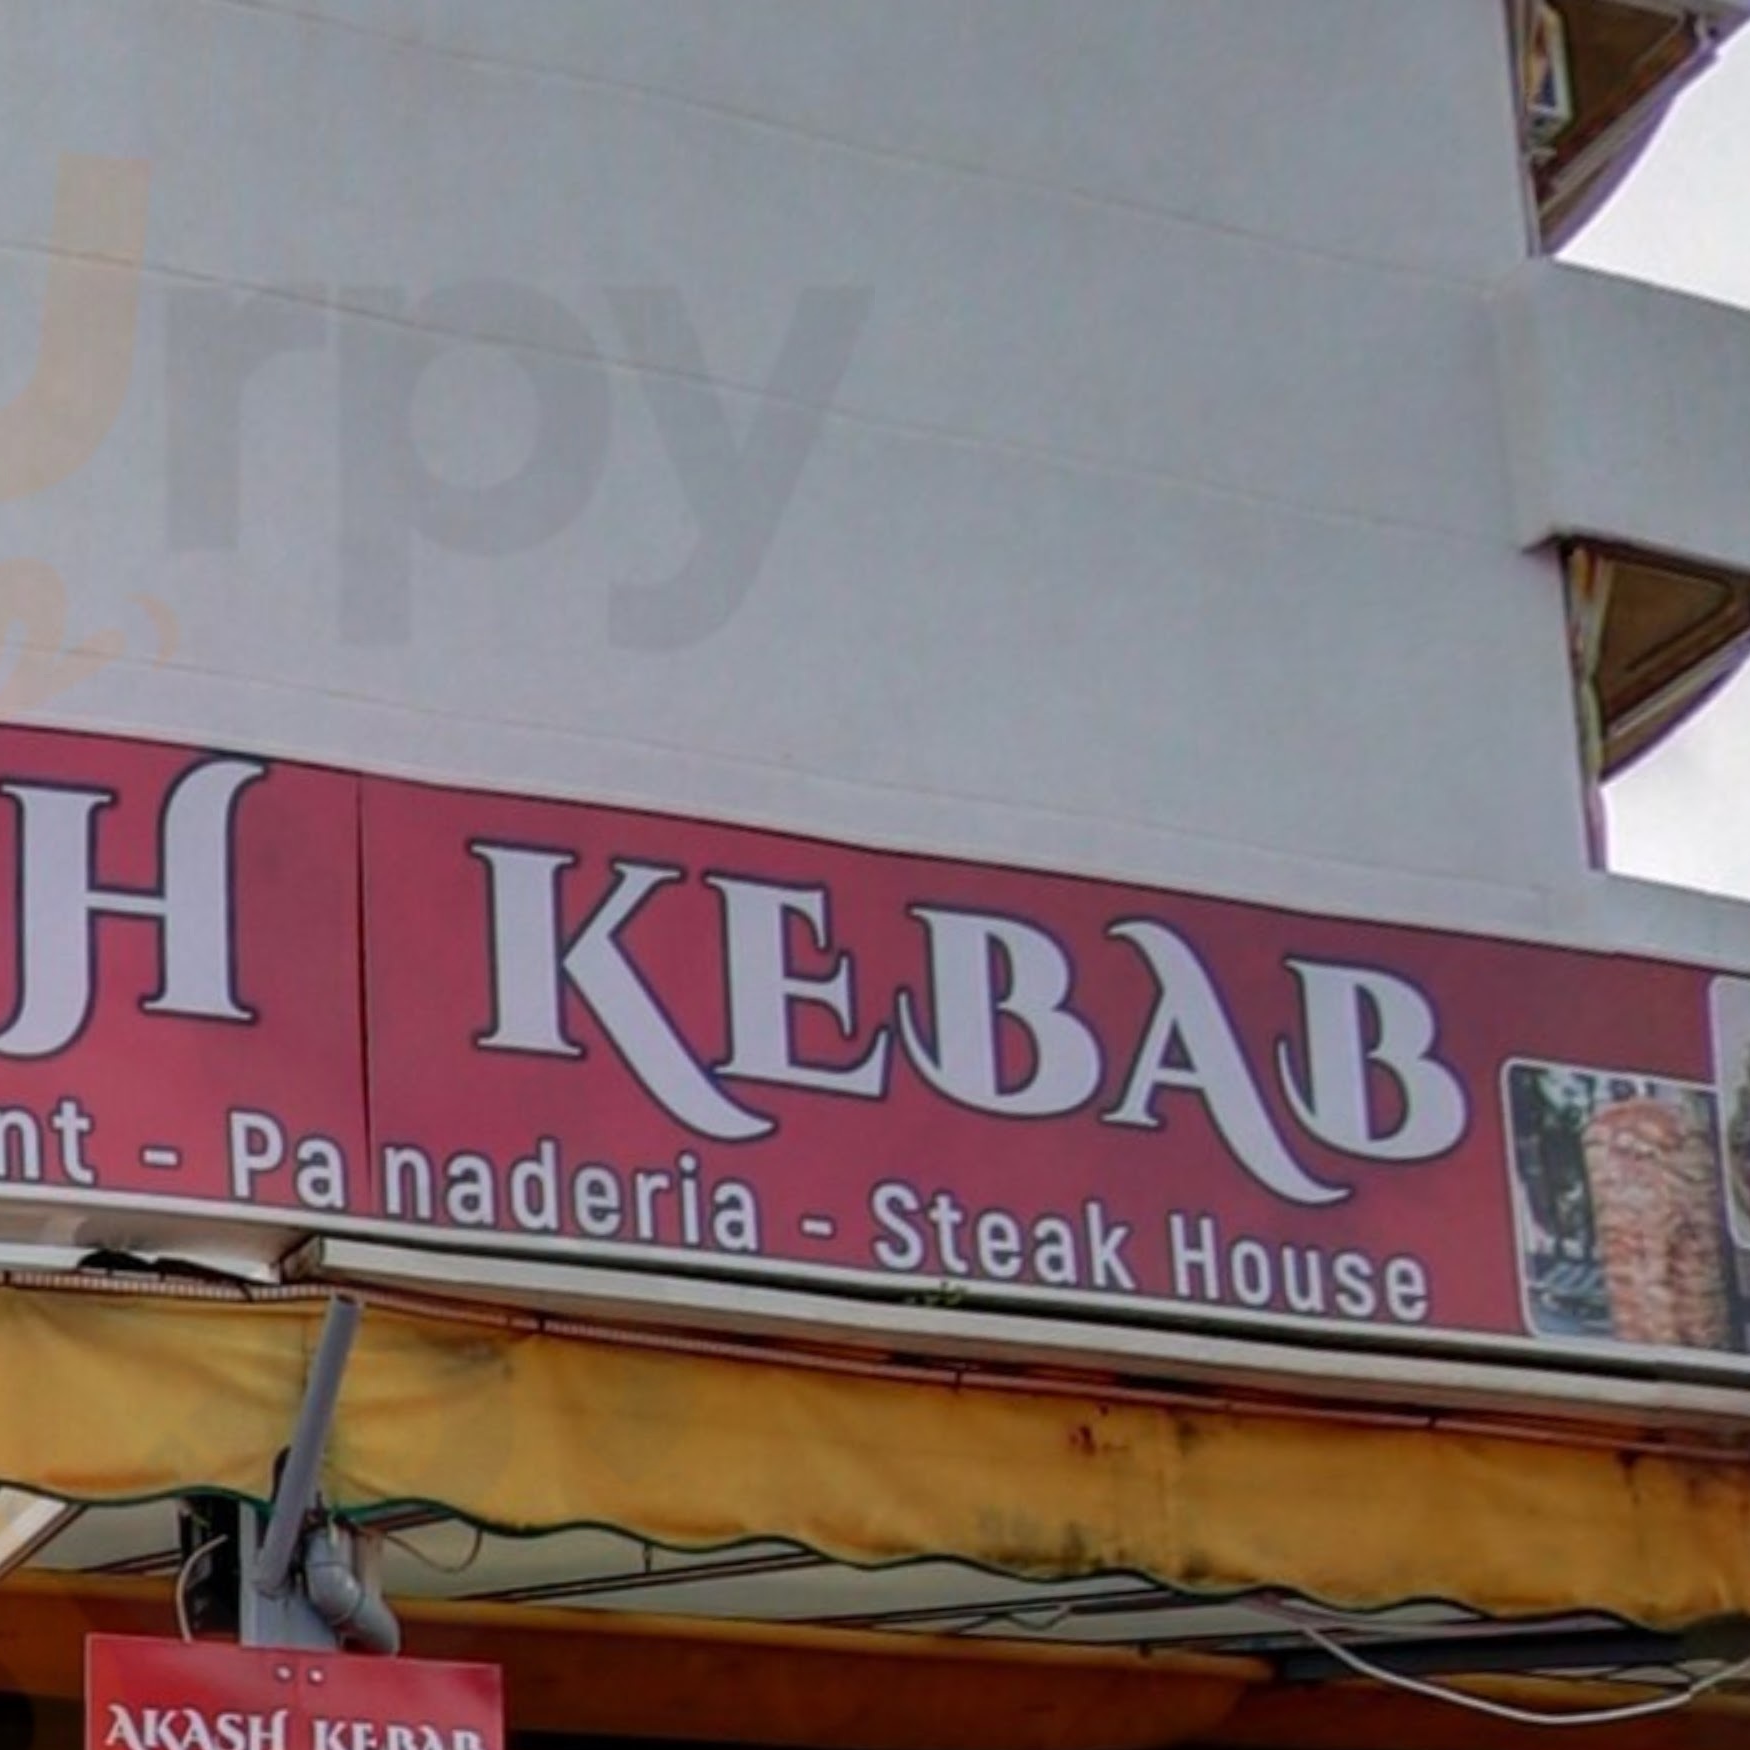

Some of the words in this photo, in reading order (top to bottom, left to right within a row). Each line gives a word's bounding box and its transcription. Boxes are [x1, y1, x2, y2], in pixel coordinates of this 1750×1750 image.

[471, 838, 1472, 1206] KEBAB
[873, 1182, 1137, 1294] Steak
[1172, 1218, 1430, 1323] House
